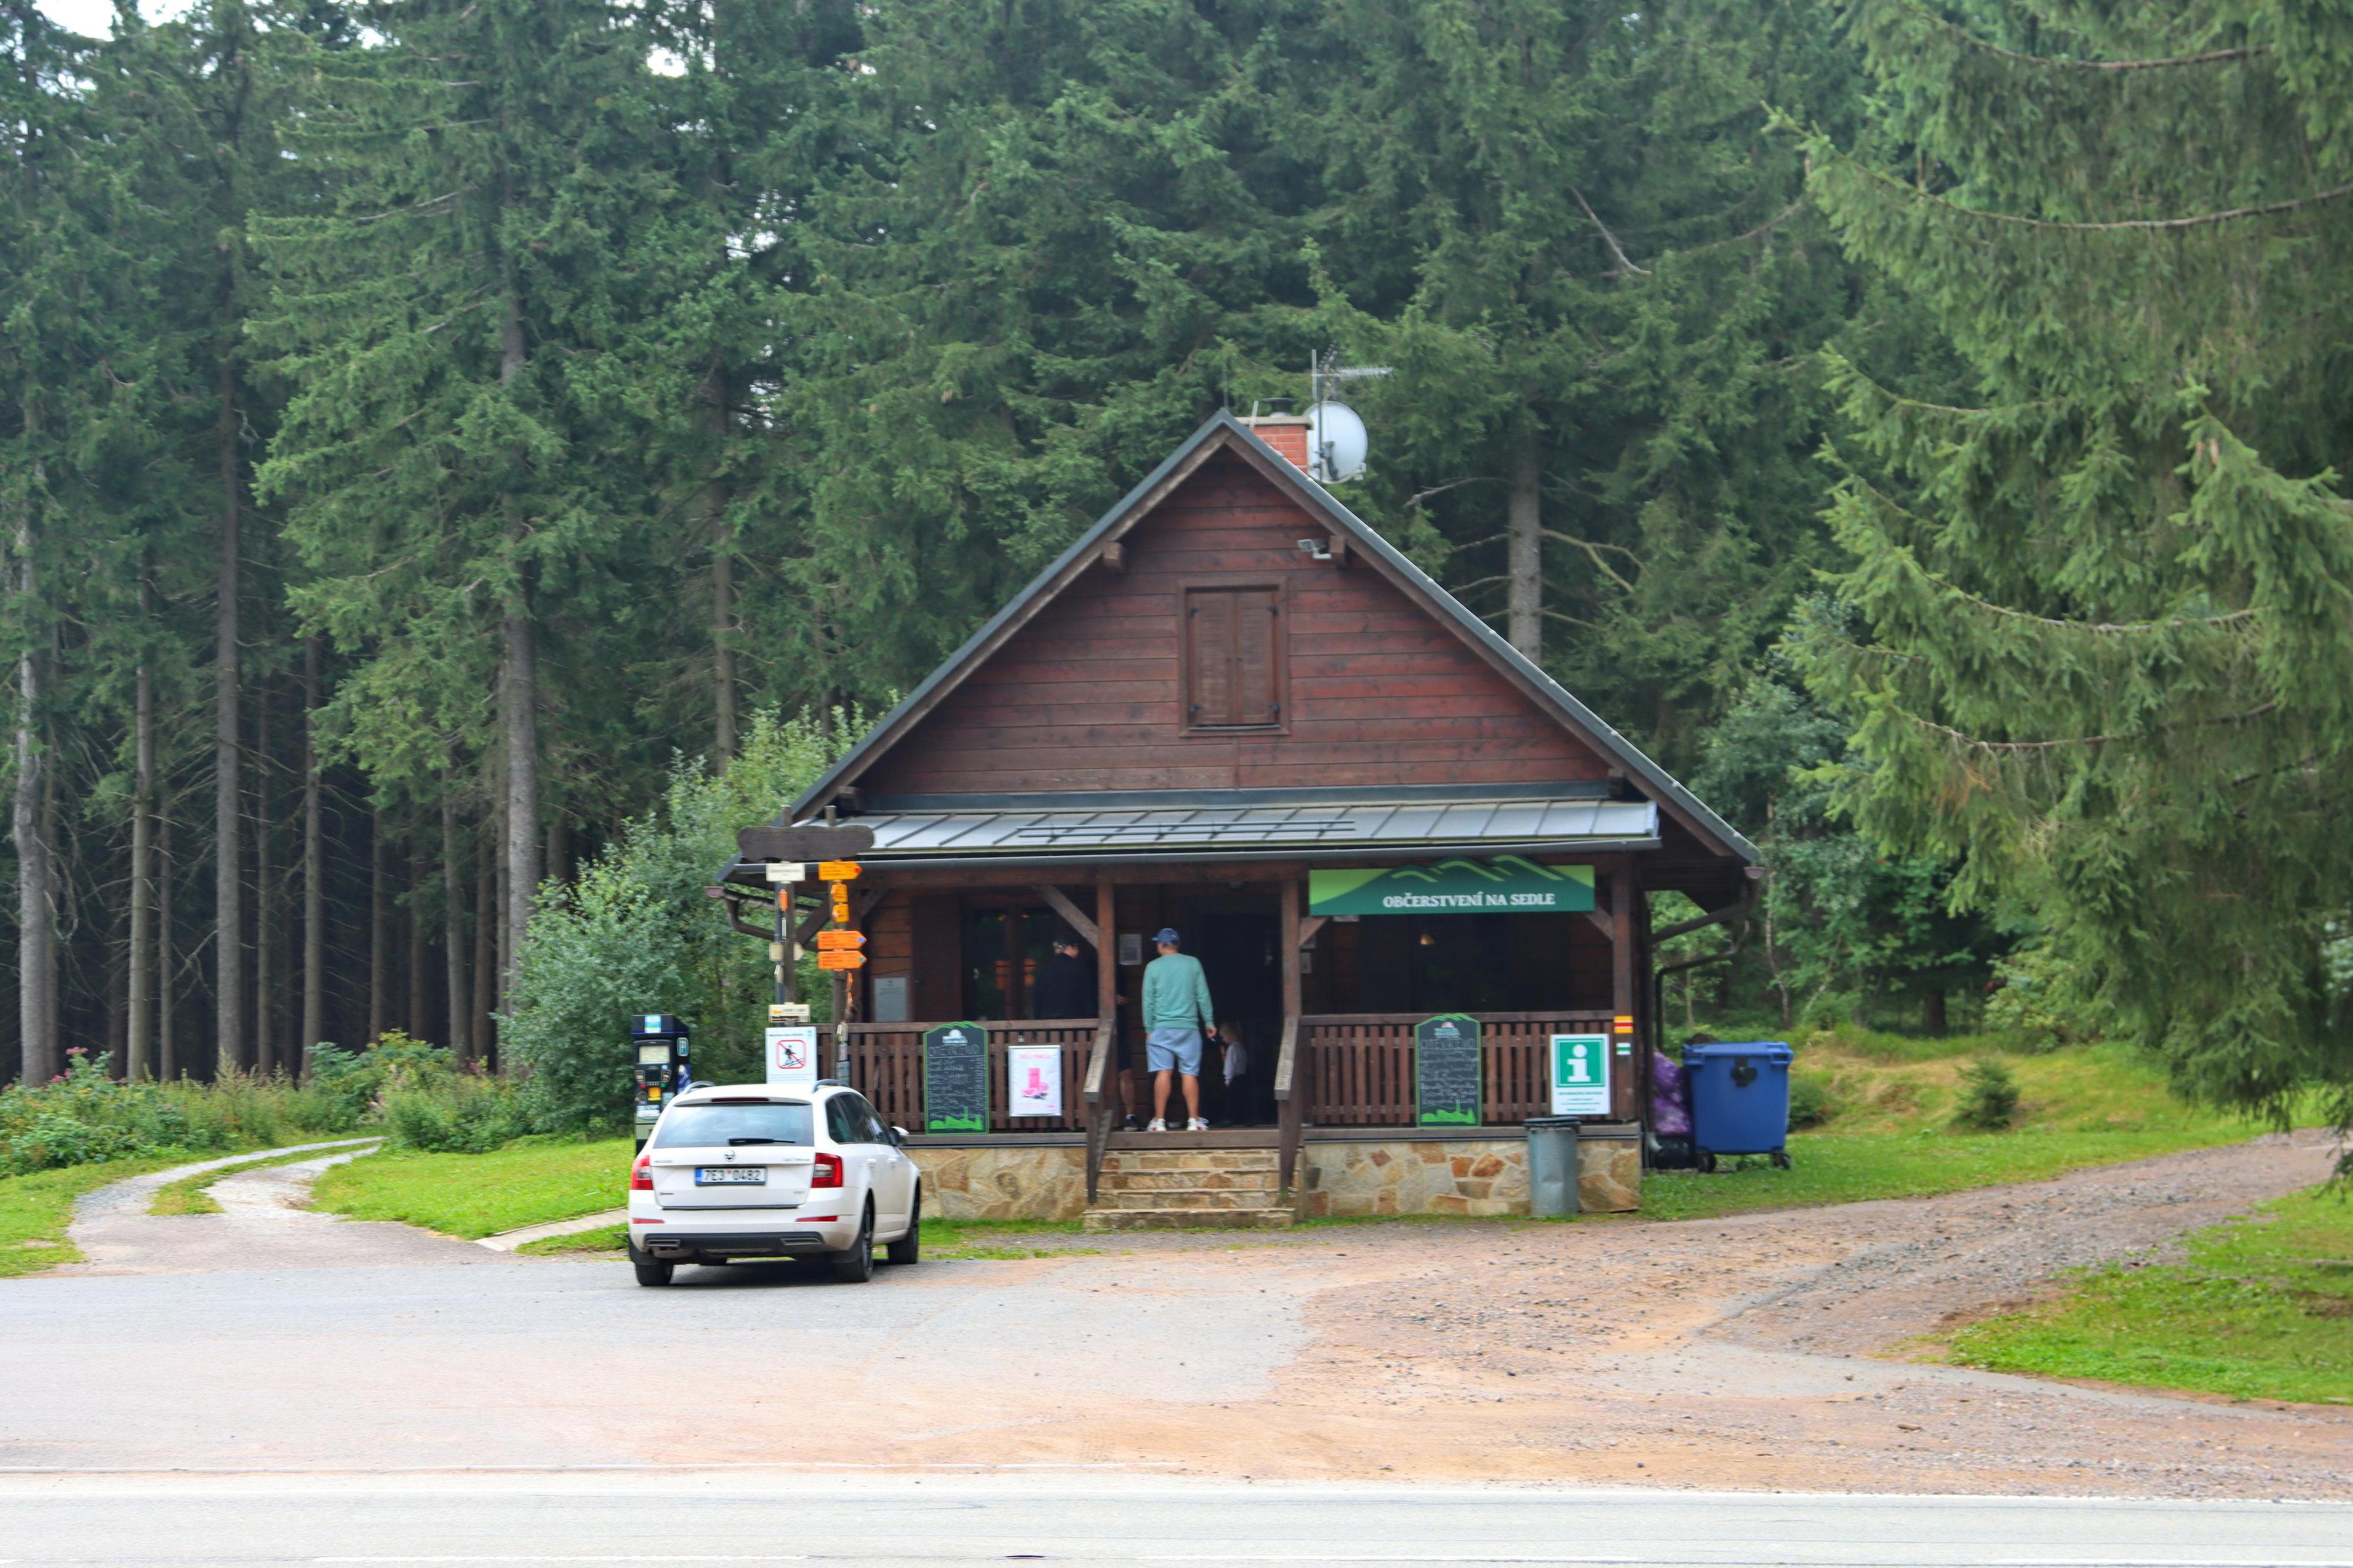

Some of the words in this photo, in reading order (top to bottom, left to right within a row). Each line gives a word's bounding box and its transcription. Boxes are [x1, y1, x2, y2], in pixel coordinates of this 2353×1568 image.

[1382, 891, 1484, 908] OBČERSTVENÍ
[1485, 895, 1508, 906] NA
[1510, 893, 1556, 906] SEDLE
[704, 1169, 725, 1181] 7E3
[732, 1169, 761, 1181] 0482
